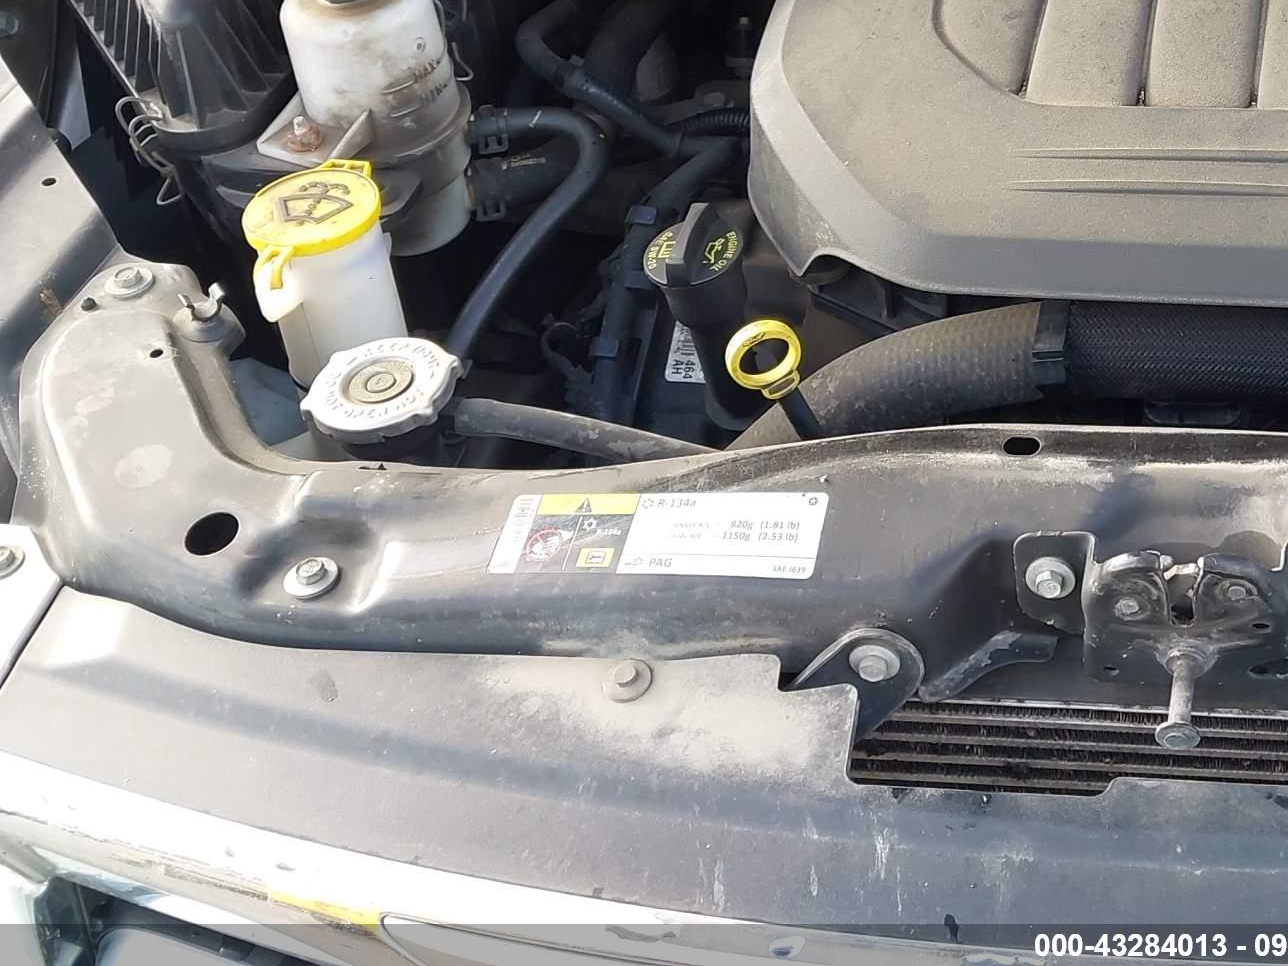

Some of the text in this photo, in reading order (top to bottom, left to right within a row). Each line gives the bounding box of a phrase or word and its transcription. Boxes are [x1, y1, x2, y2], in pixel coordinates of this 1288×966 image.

[709, 231, 738, 272] ENGINE OIL
[671, 358, 683, 375] AH
[656, 498, 697, 508] R-134a
[730, 520, 753, 531] 820g
[722, 532, 751, 542] 1150g
[648, 558, 672, 568] PAG
